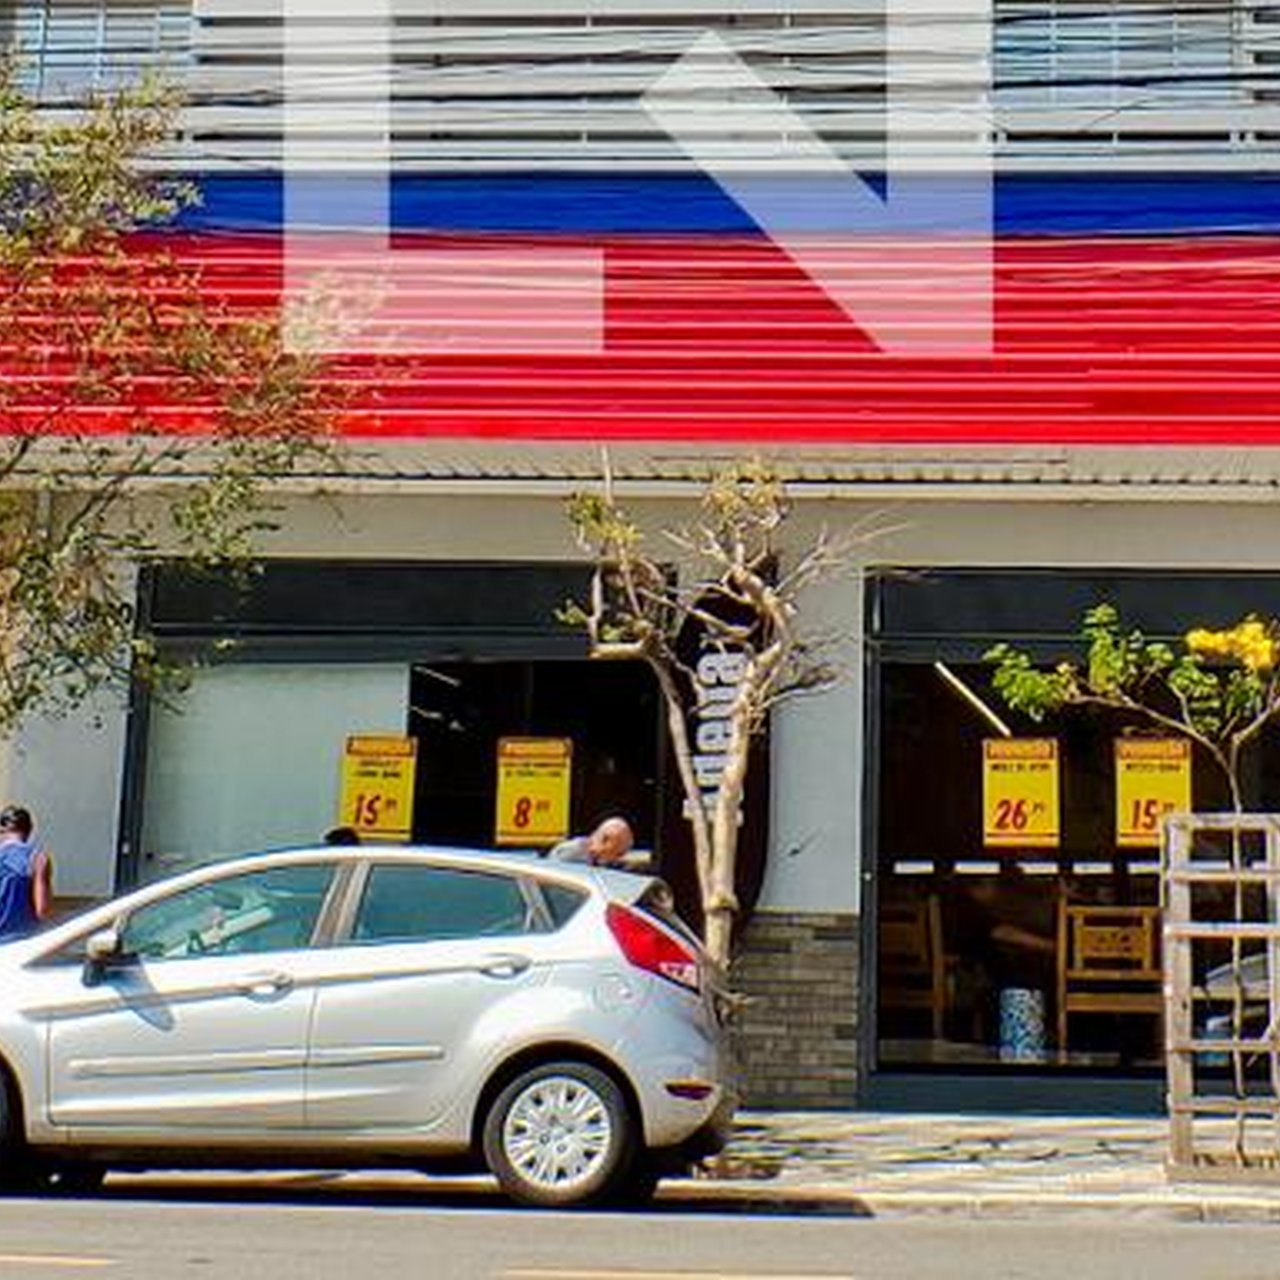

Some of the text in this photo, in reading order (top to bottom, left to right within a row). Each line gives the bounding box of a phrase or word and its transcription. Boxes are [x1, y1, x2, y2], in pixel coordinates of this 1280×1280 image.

[354, 793, 382, 826] 15
[512, 795, 532, 829] 8
[993, 798, 1028, 830] 26
[1131, 798, 1158, 831] 15
